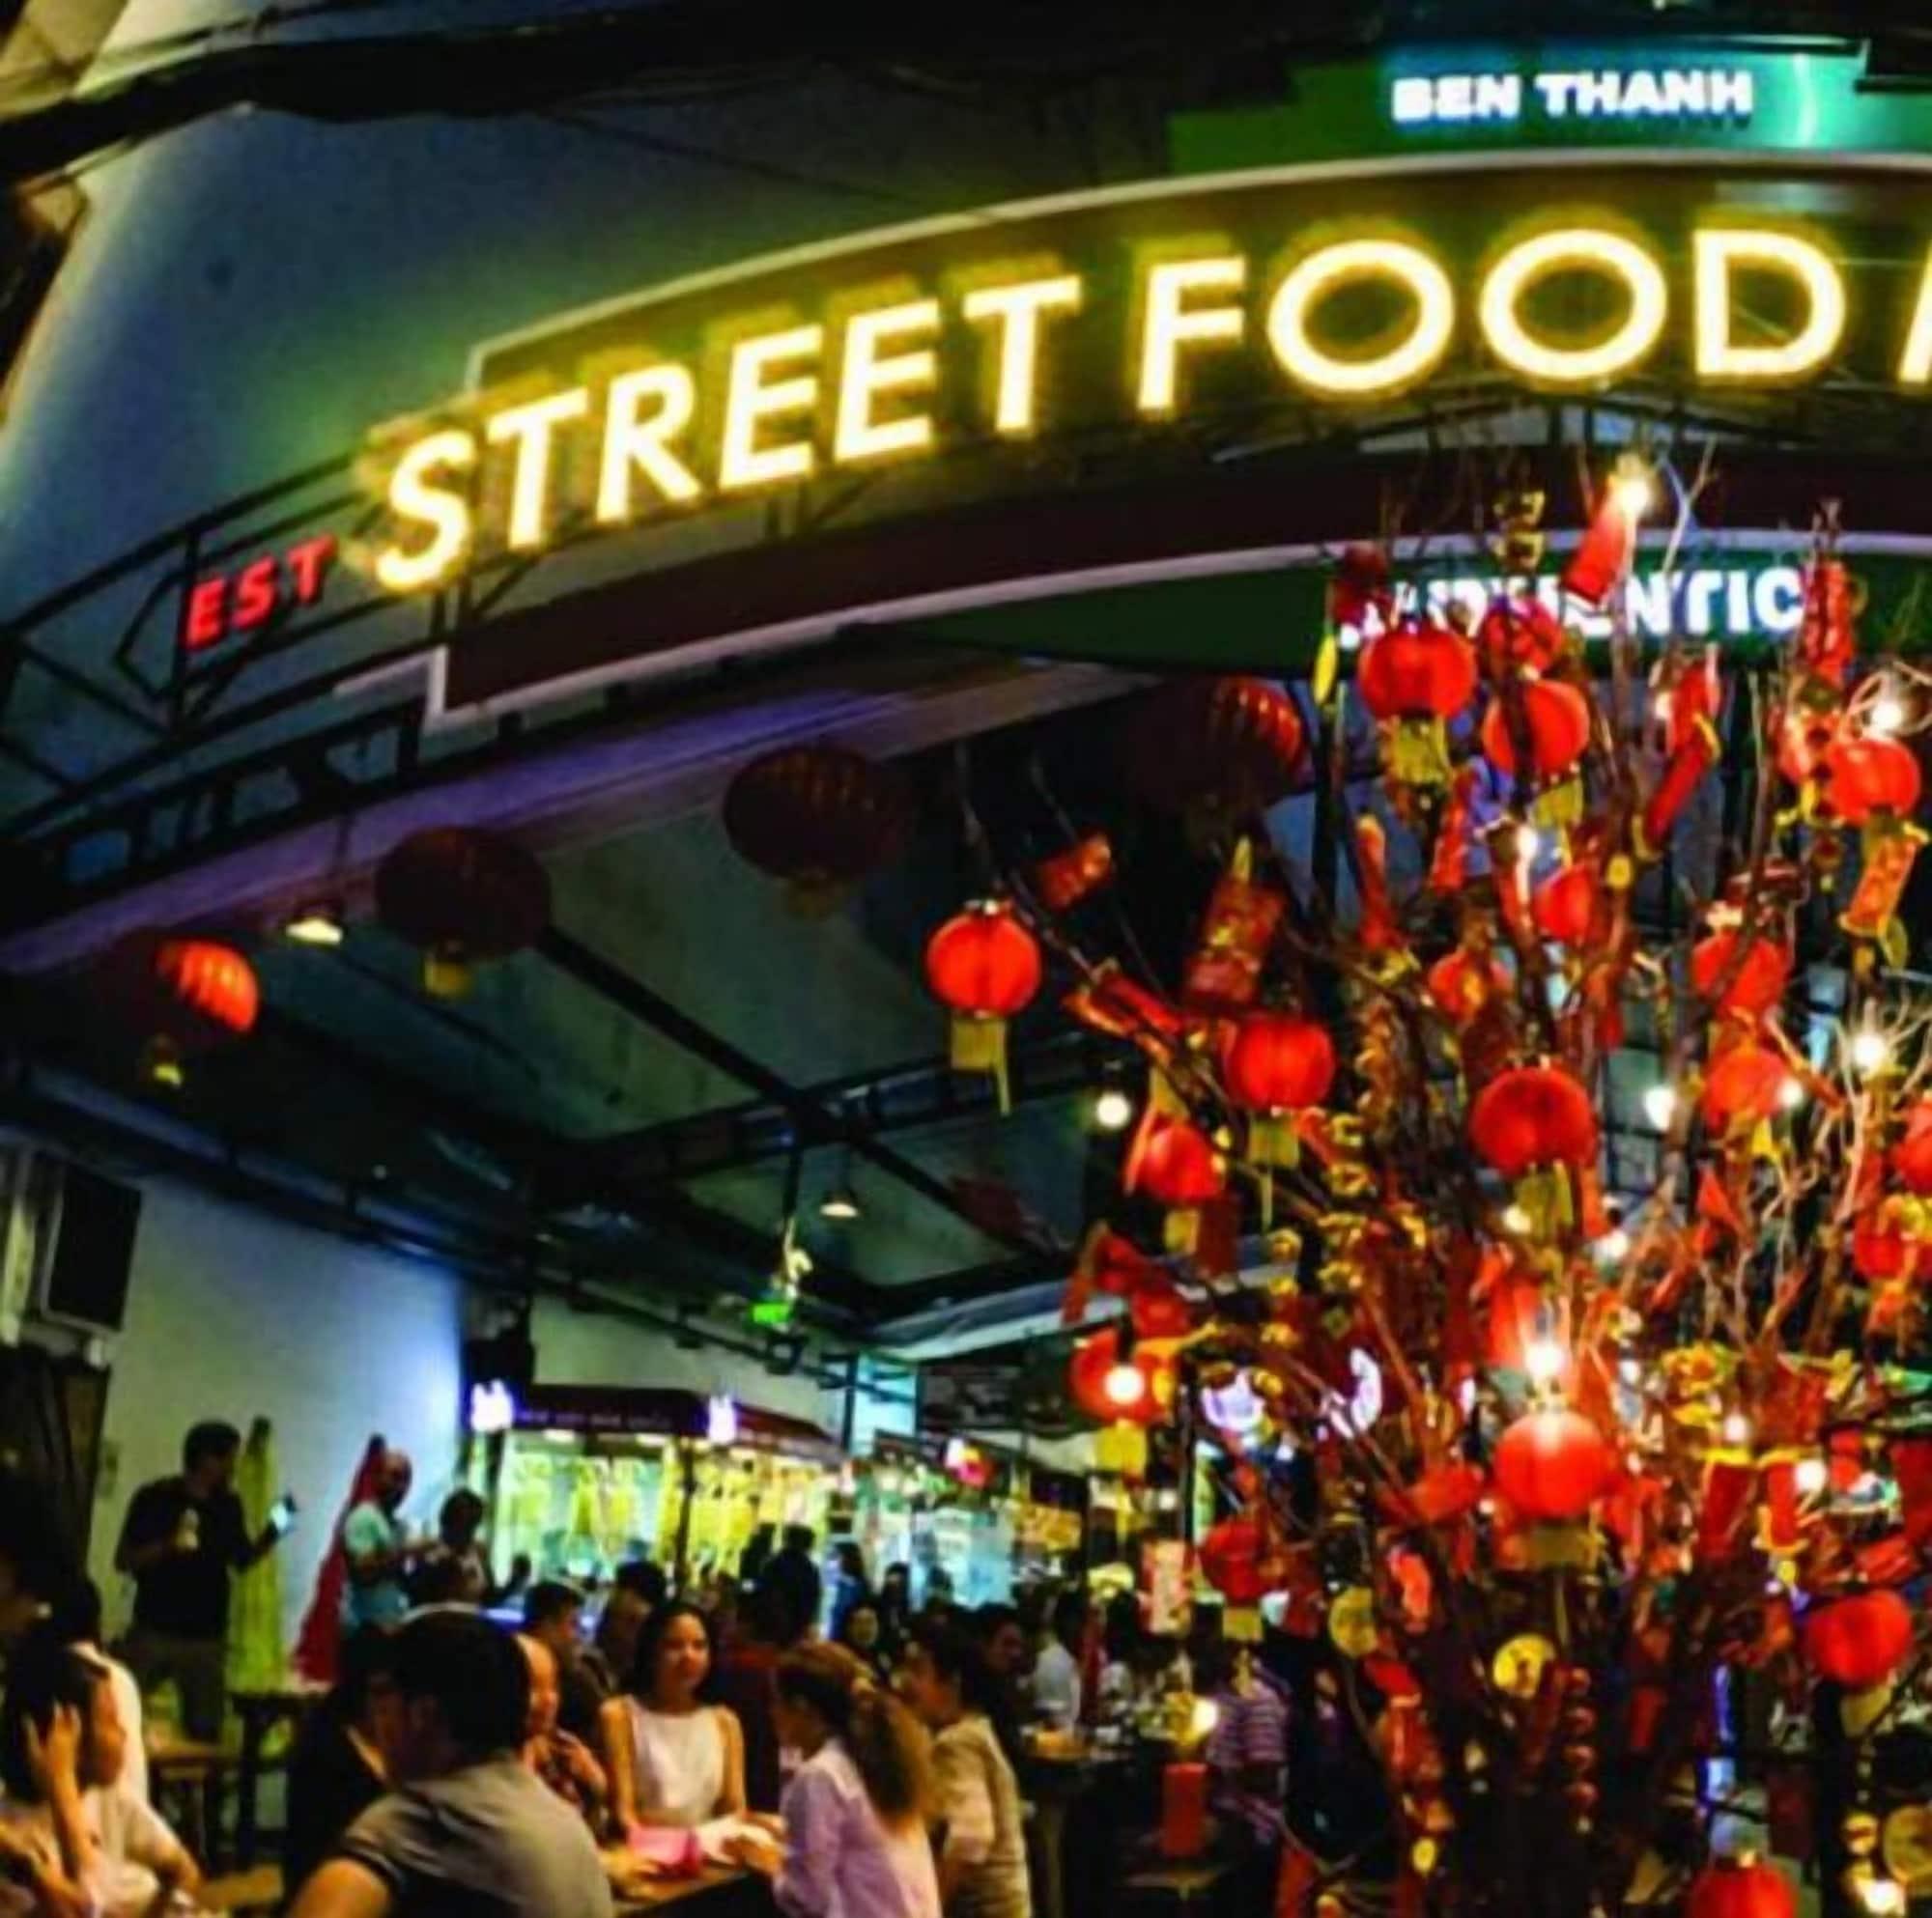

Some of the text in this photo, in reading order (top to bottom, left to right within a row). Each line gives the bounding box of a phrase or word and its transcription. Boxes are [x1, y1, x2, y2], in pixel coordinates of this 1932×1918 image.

[1392, 70, 1753, 122] BEN THANH
[376, 273, 1082, 592] STREET
[1136, 228, 1847, 410] FOOD
[184, 532, 336, 649] EST
